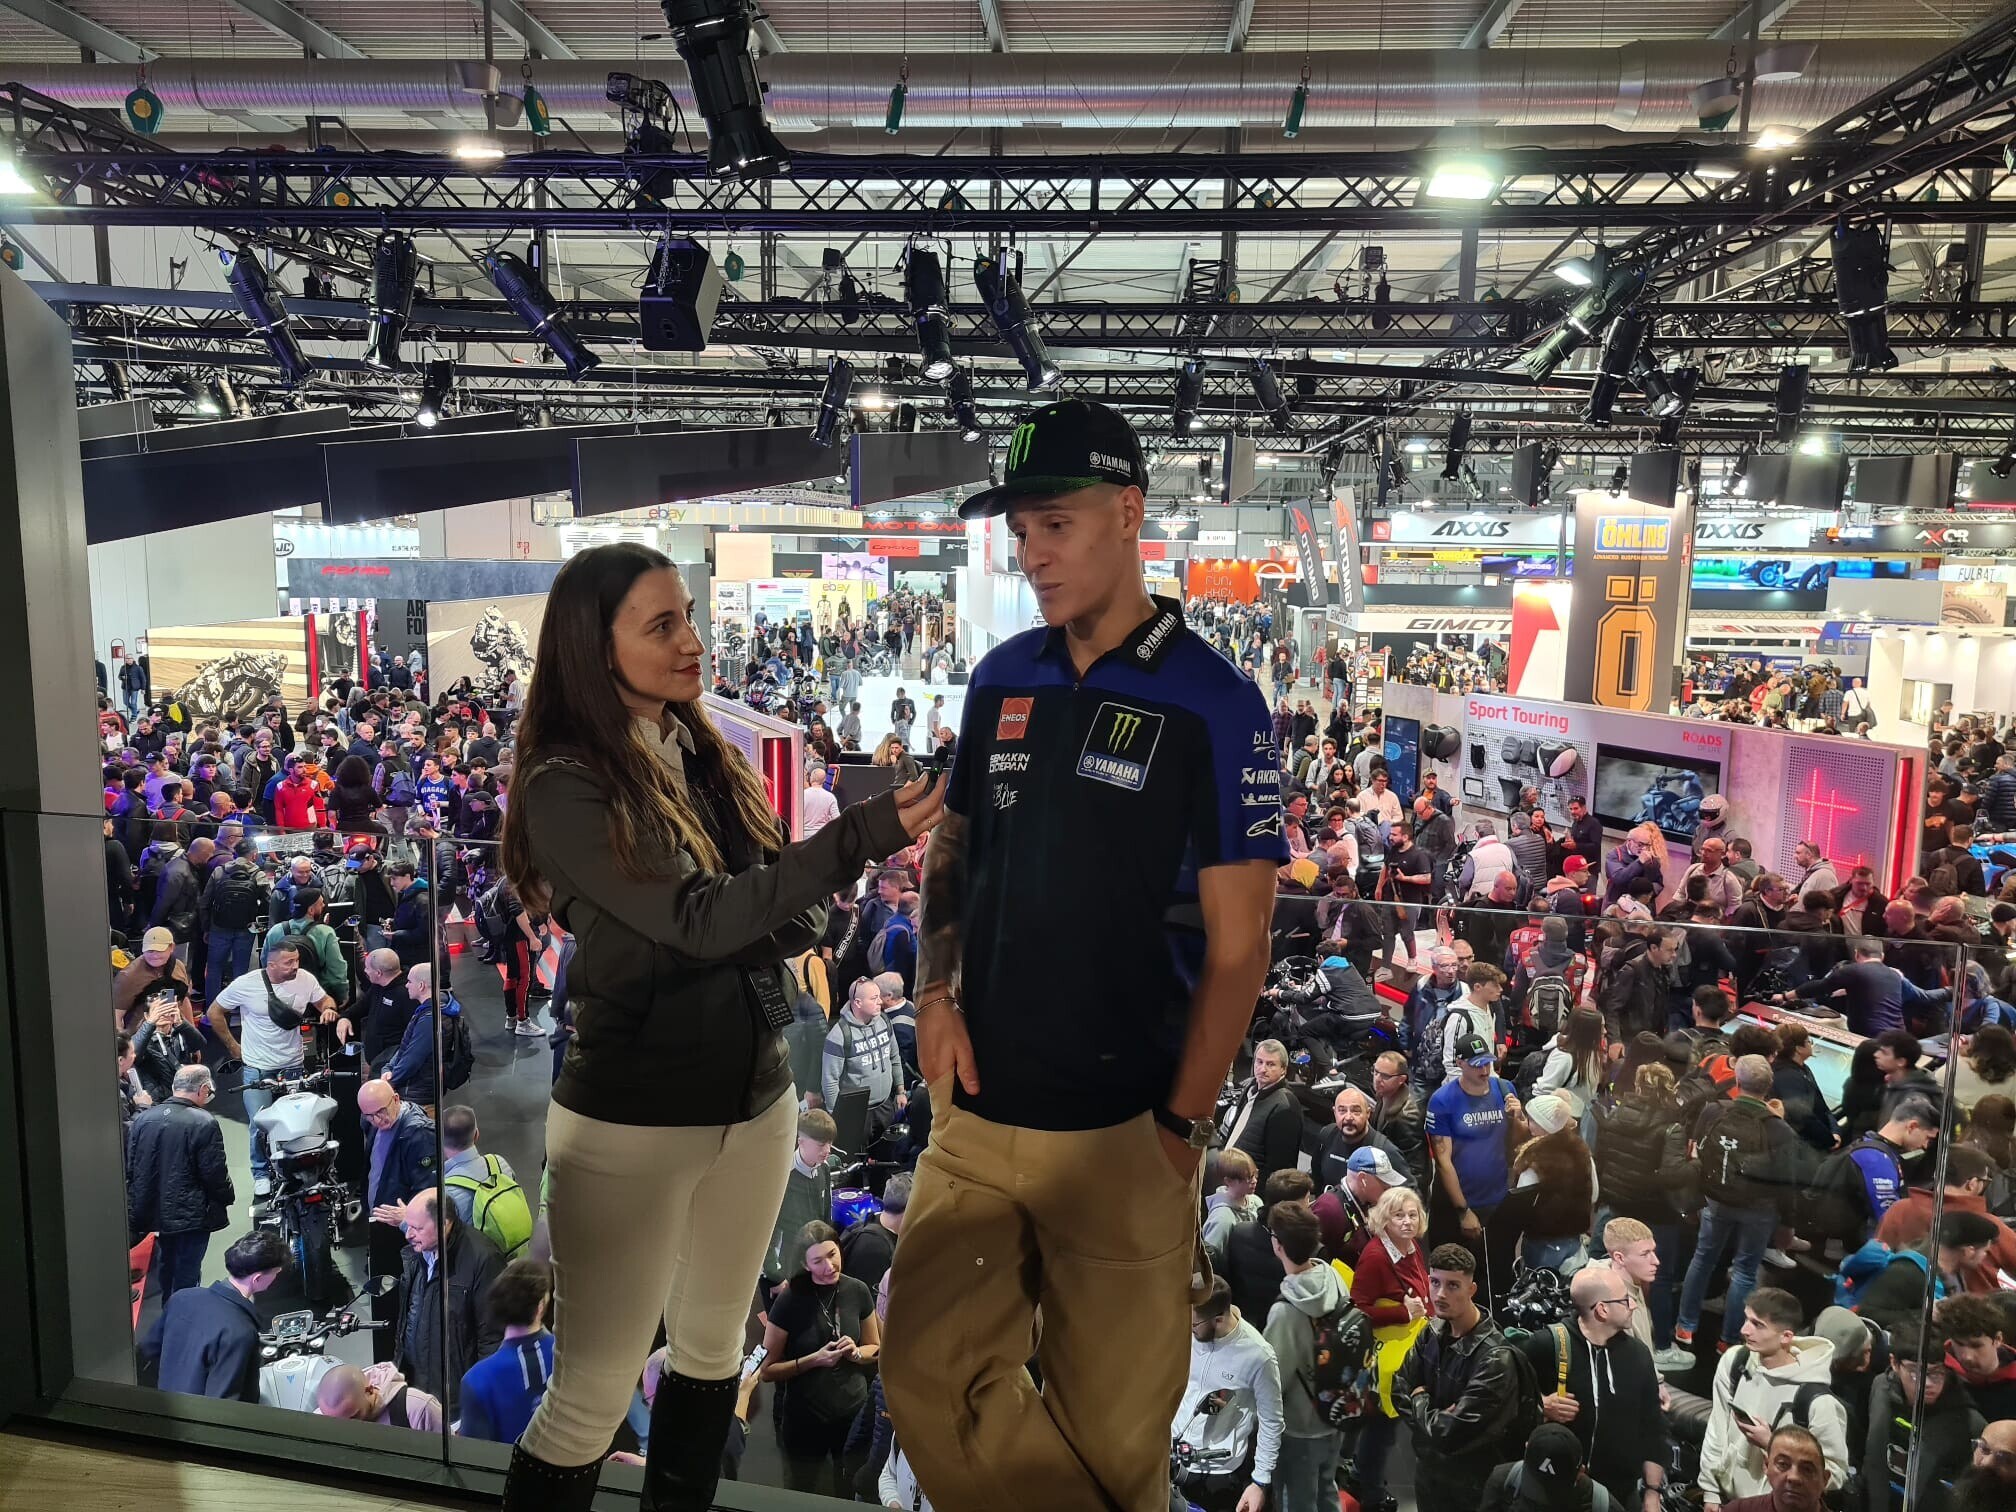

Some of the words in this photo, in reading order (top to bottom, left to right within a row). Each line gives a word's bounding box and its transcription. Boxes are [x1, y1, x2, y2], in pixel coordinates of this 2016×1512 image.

[1101, 453, 1131, 474] YAMAHA
[649, 505, 687, 522] ebay
[1431, 520, 1511, 537] AXXIS
[274, 542, 291, 552] JC
[945, 542, 968, 550] X-C
[823, 581, 850, 594] ebay
[1143, 612, 1177, 649] YAMAHA
[1406, 618, 1513, 631] GIMOT
[1001, 713, 1027, 722] ENEOS
[1469, 701, 1508, 720] Sport
[1512, 707, 1569, 734] Touring
[1682, 730, 1723, 747] ROADS
[1095, 757, 1140, 782] YAMAHA
[1472, 1109, 1504, 1122] YAMAHA
